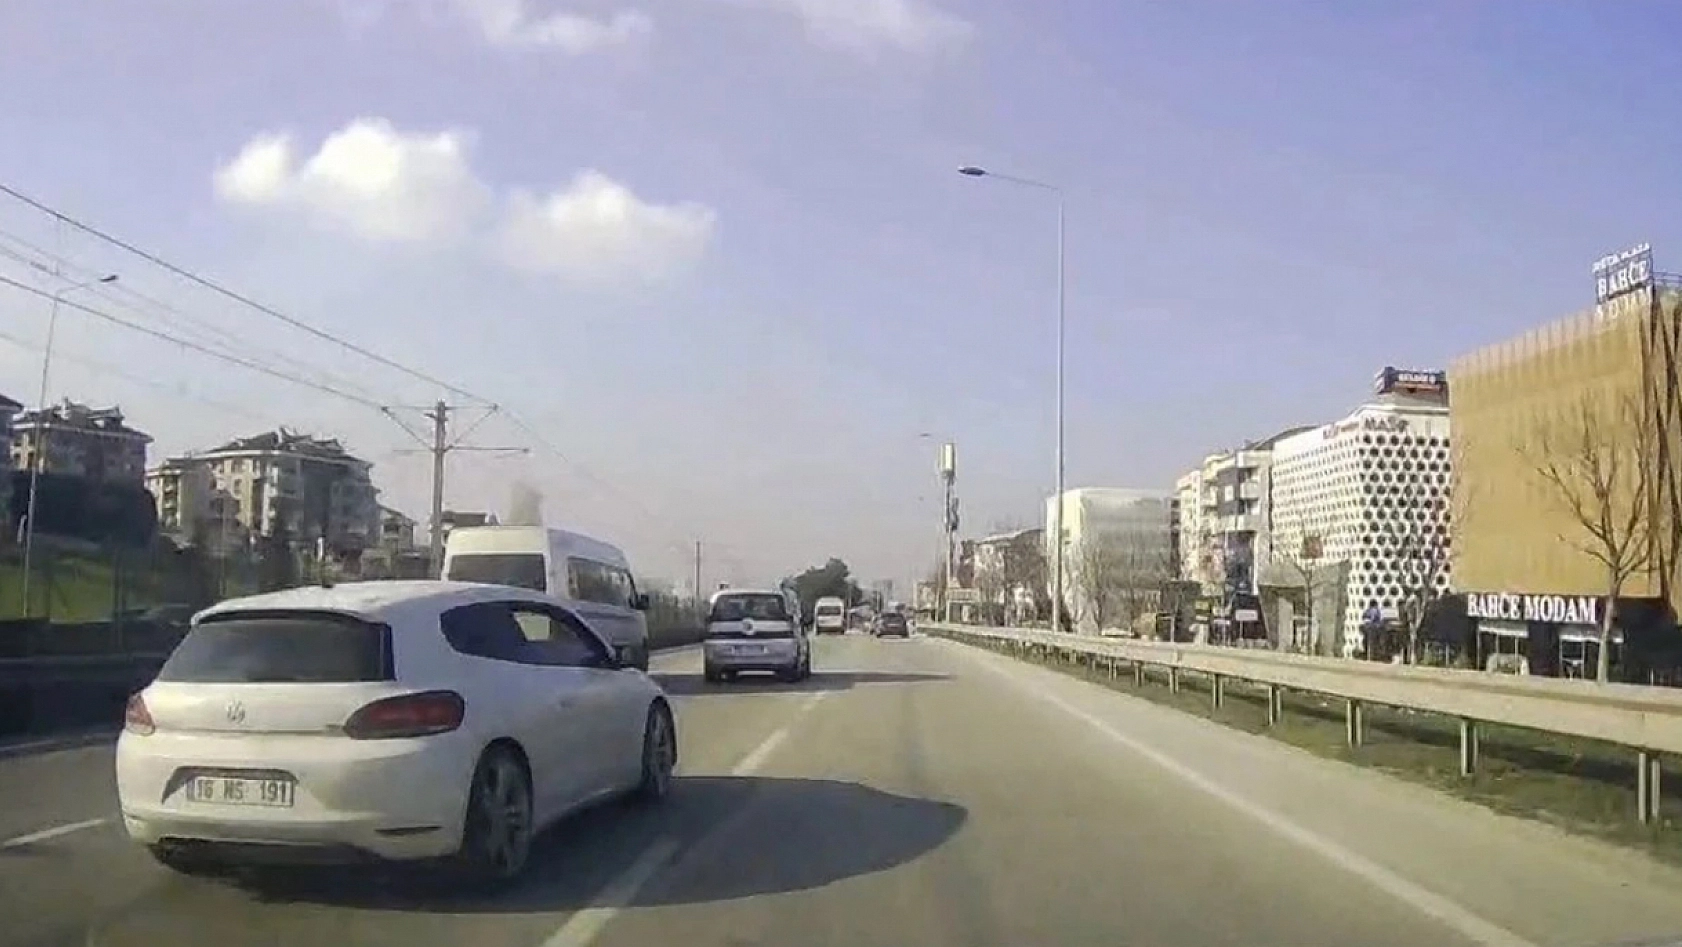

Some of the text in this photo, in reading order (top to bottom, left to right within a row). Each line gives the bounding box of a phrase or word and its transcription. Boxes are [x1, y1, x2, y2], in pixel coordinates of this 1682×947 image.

[1524, 595, 1598, 624] MODAM
[197, 780, 214, 799] 16
[261, 780, 287, 803] 191
